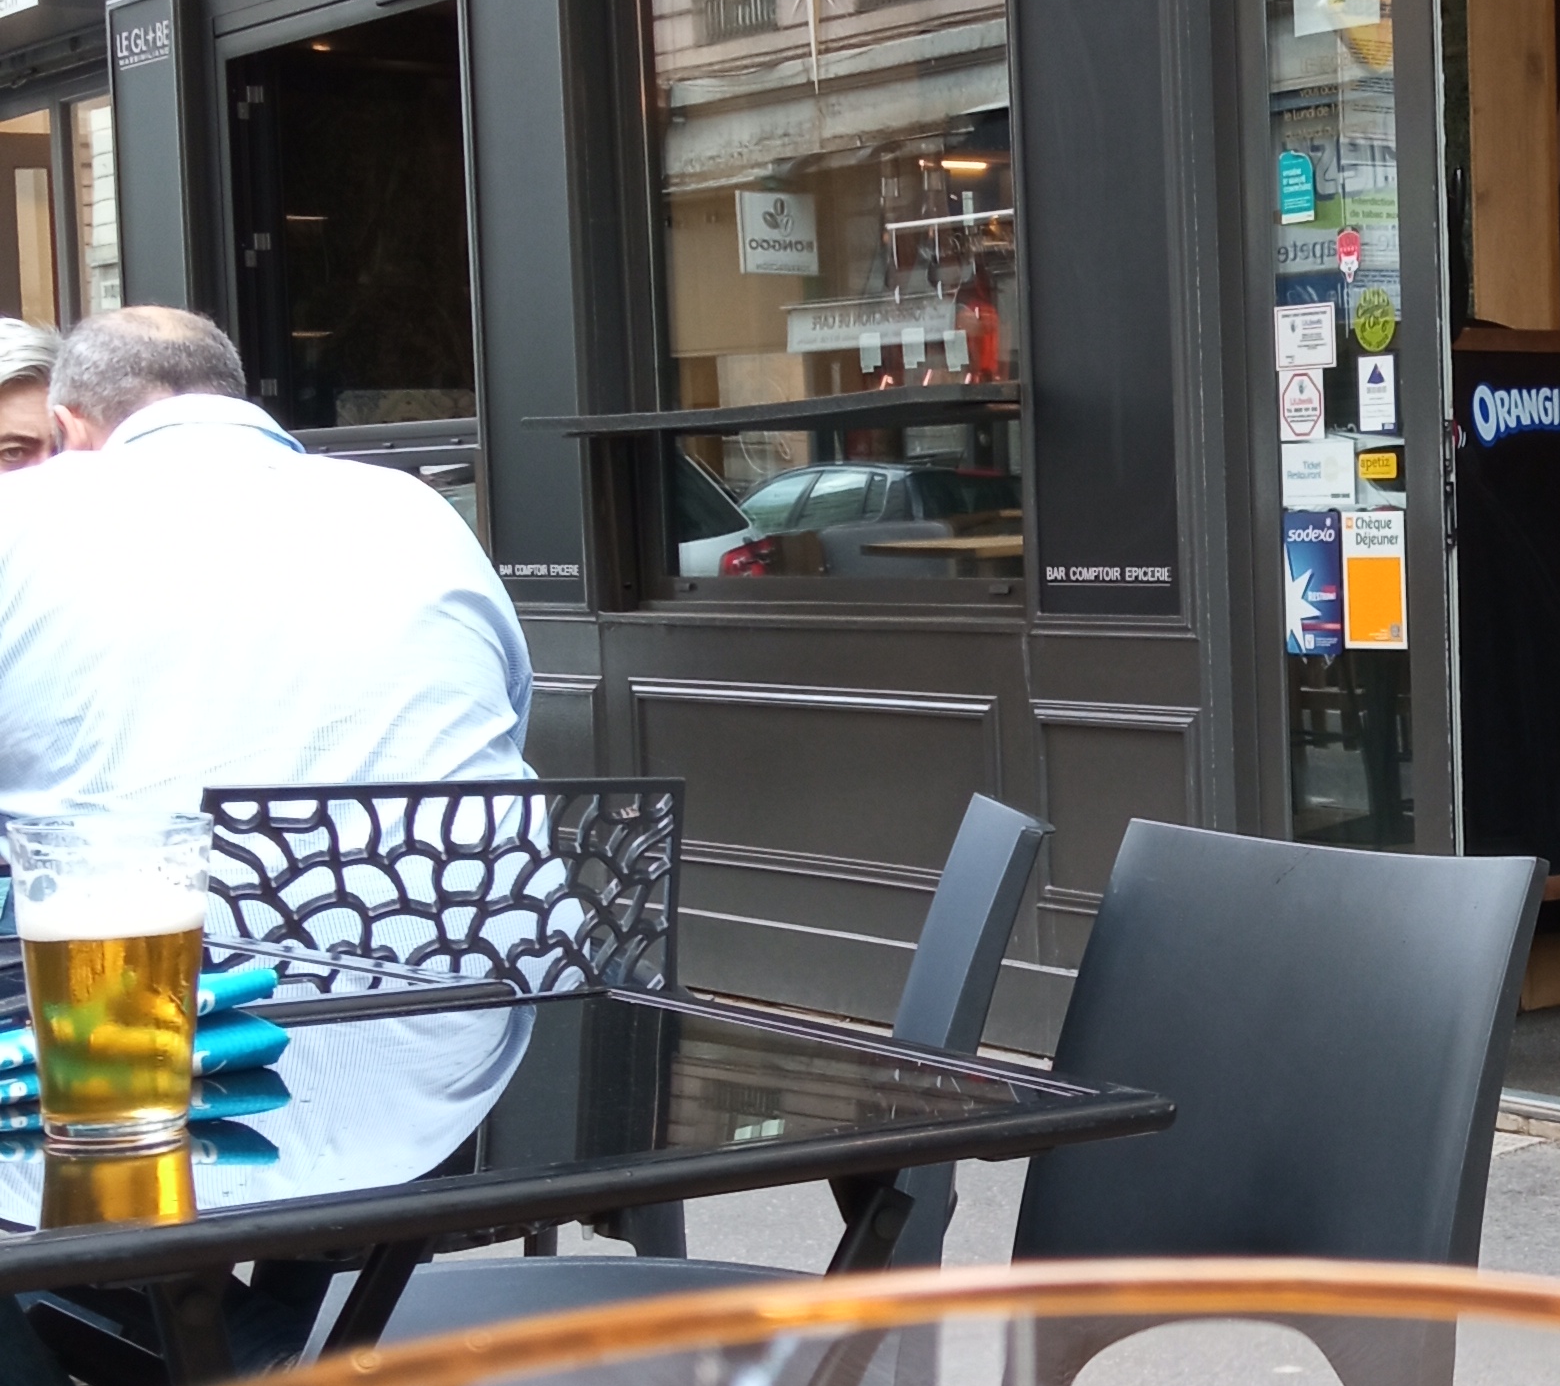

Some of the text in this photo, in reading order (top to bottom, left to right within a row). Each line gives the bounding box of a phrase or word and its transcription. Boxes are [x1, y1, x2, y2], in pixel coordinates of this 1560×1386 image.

[116, 31, 130, 58] LE
[1360, 454, 1390, 470] apetiz
[1355, 515, 1393, 532] Chèque
[1287, 524, 1336, 543] sodexo
[1355, 532, 1399, 549] Déjeuner
[499, 564, 513, 576] BAR
[1046, 567, 1172, 582] BAR COMPTOIR EPICERIE
